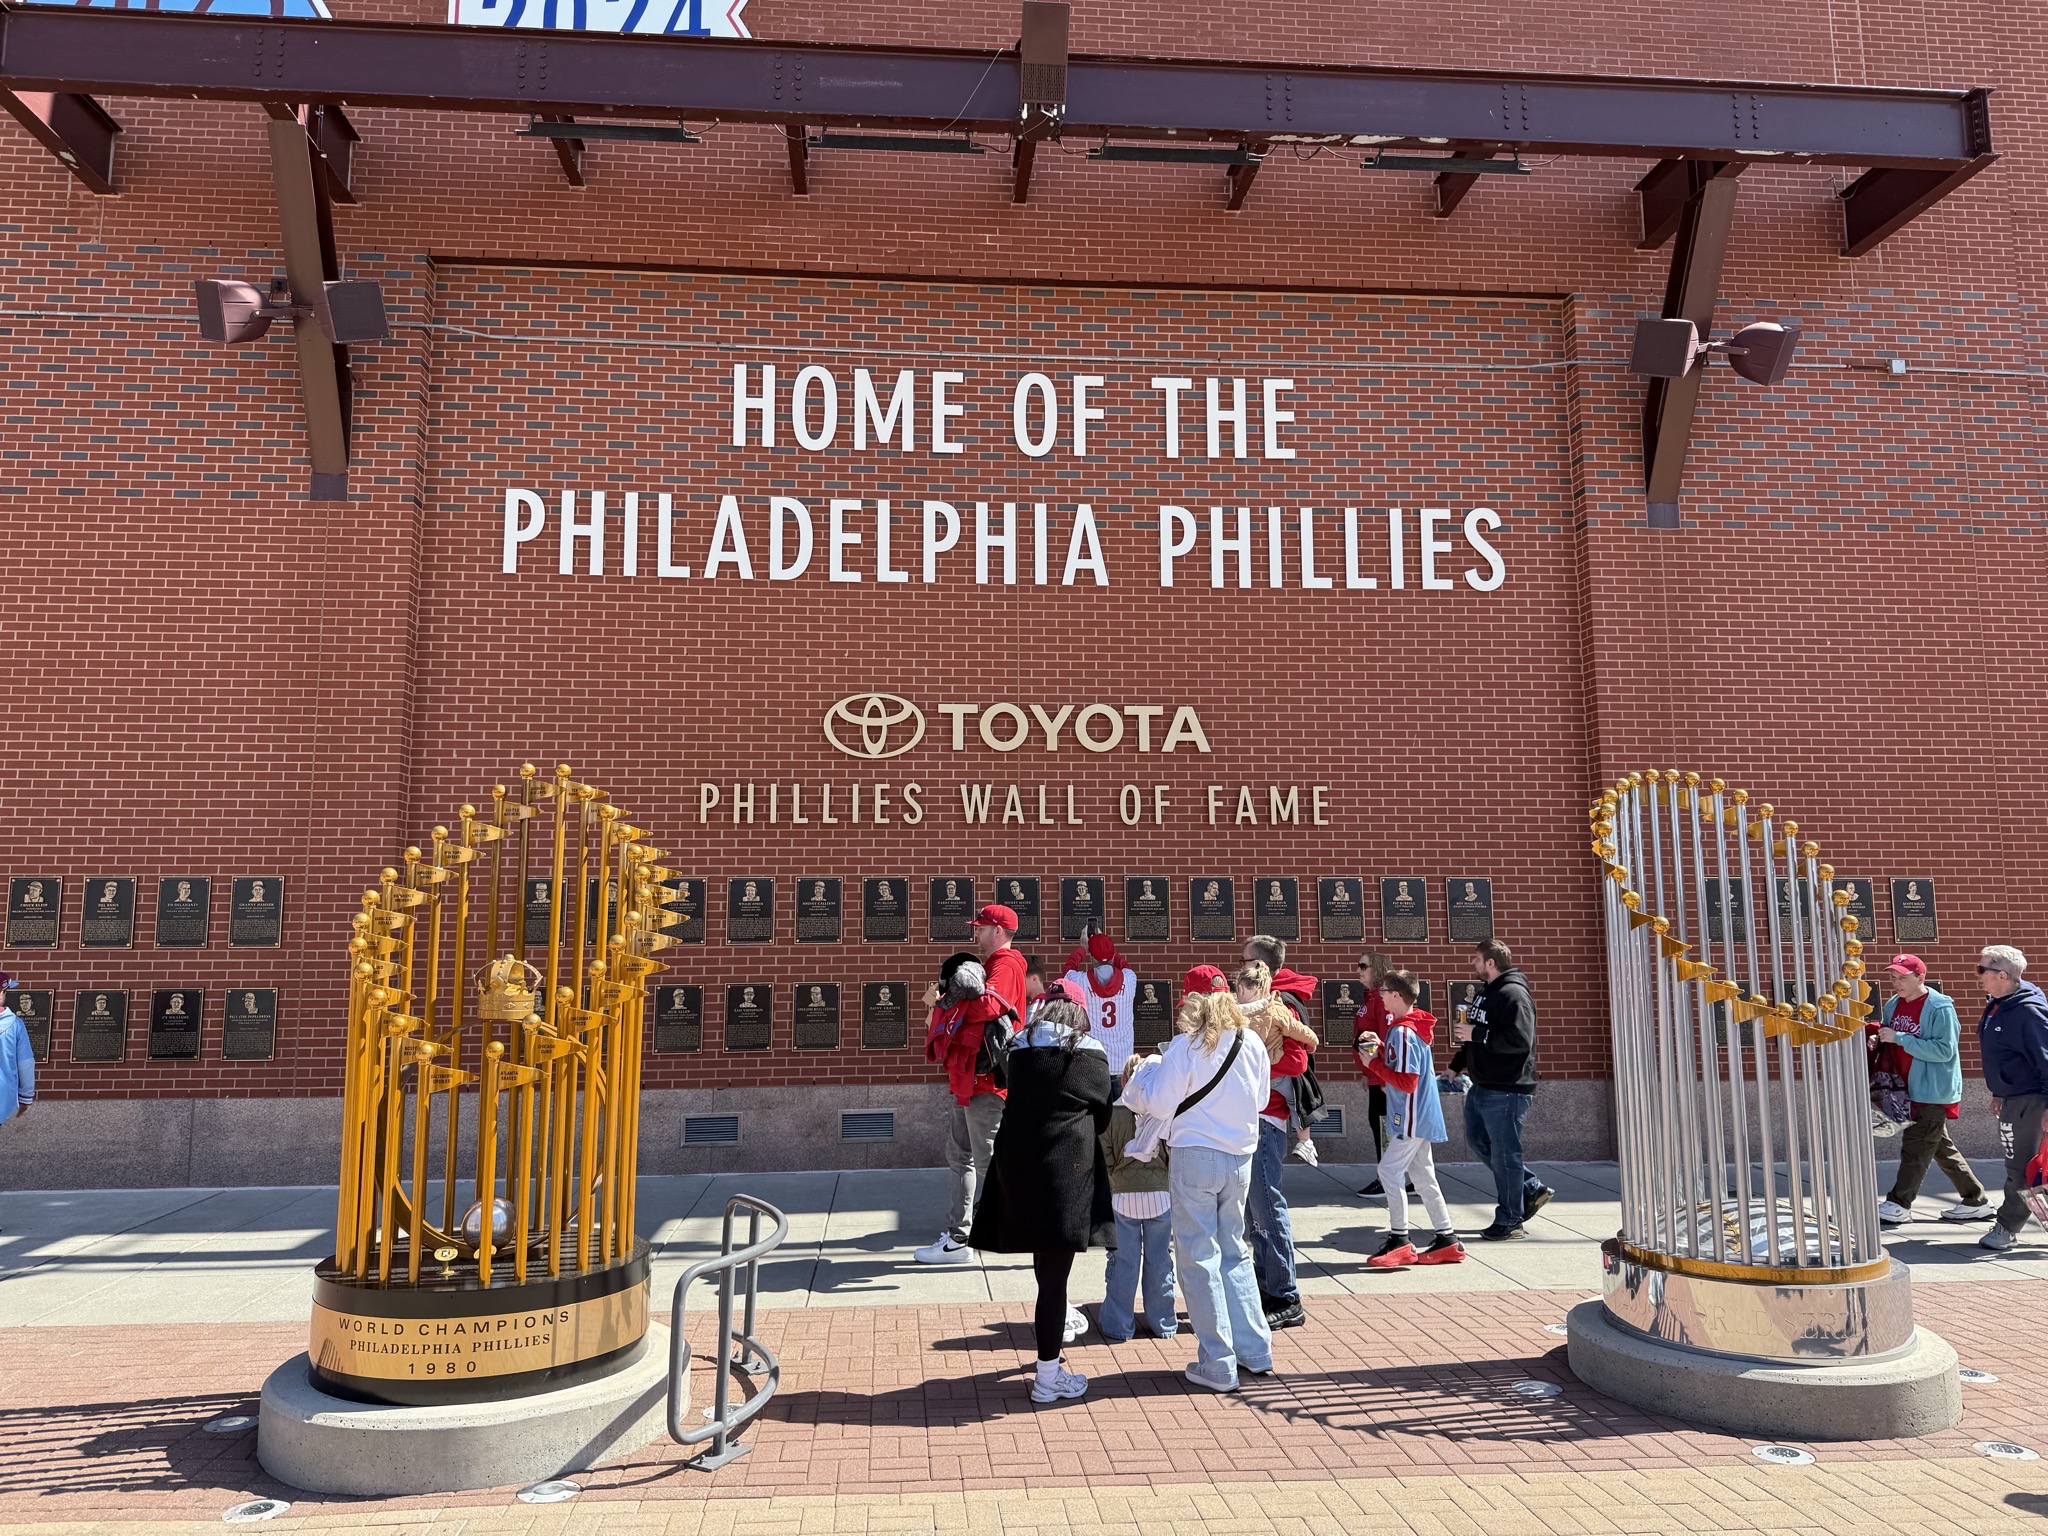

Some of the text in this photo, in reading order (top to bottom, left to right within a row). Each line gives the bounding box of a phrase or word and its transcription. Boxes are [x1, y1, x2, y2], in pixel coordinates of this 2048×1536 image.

[732, 363, 1297, 461] HOME OF THE
[502, 488, 1507, 594] PHILADELPHIA PHILLIES
[937, 702, 1212, 753] TOYOTA
[699, 782, 1330, 827] PHILLIES WALL OF FAME
[1101, 1001, 1117, 1029] 3
[338, 1311, 569, 1337] WORLD CHAMPIONS
[1663, 1297, 1772, 1336] WORLD
[350, 1333, 551, 1355] PHILADELPHIA PHILLIES
[408, 1360, 477, 1375] 1980
